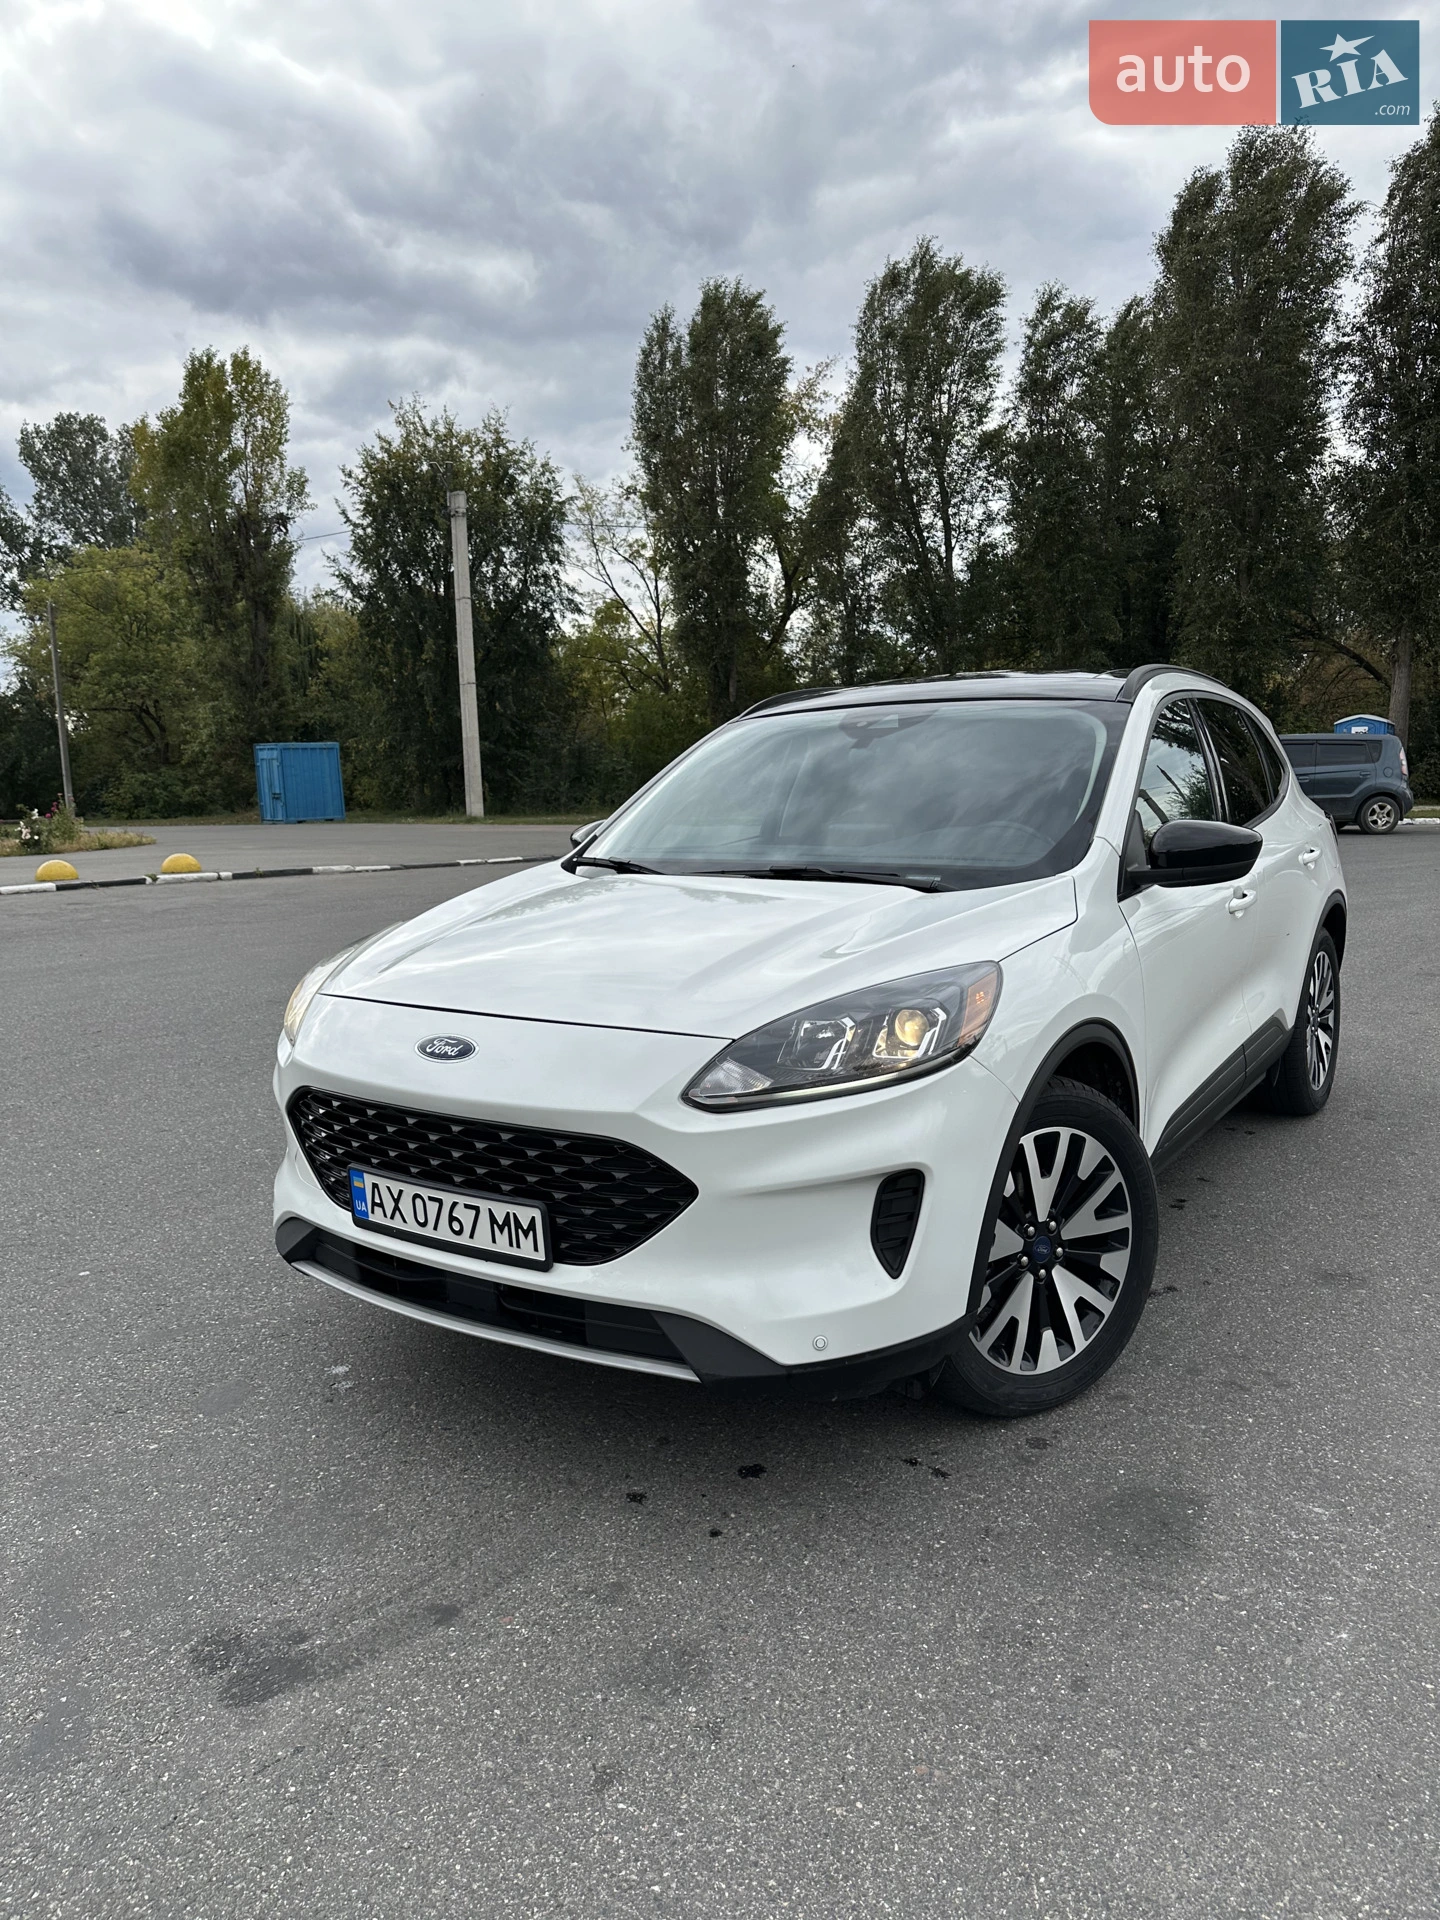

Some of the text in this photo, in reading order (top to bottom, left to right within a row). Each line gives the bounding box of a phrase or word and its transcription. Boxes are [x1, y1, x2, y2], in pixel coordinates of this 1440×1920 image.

[426, 1037, 463, 1056] Ford
[355, 1199, 367, 1213] UA
[370, 1181, 539, 1253] AX 0767 MM
